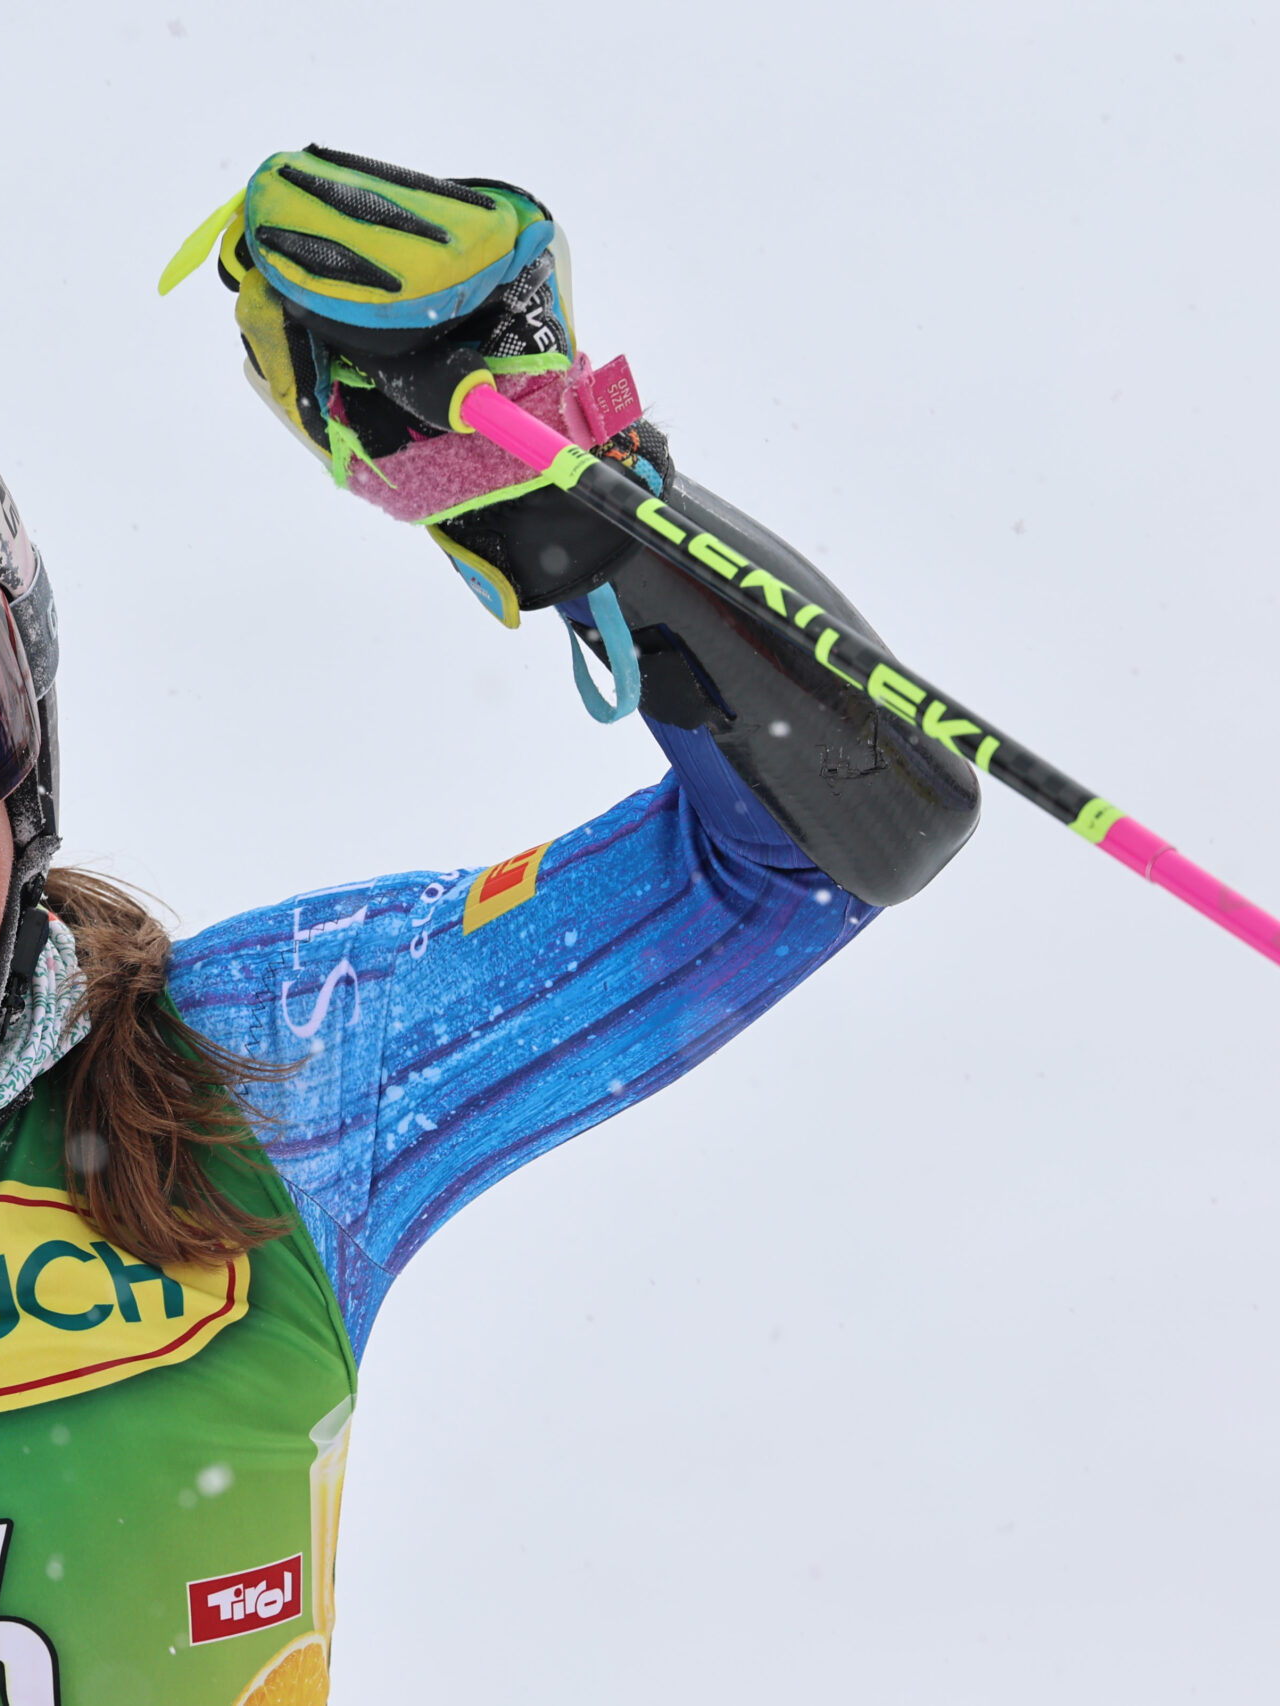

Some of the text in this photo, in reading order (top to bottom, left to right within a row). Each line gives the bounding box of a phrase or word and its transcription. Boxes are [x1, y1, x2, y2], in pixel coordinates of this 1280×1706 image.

[607, 384, 625, 413] SIZE
[618, 378, 634, 408] ONE
[636, 498, 1001, 774] LEKI LEKI
[207, 1571, 292, 1621] Tirol
